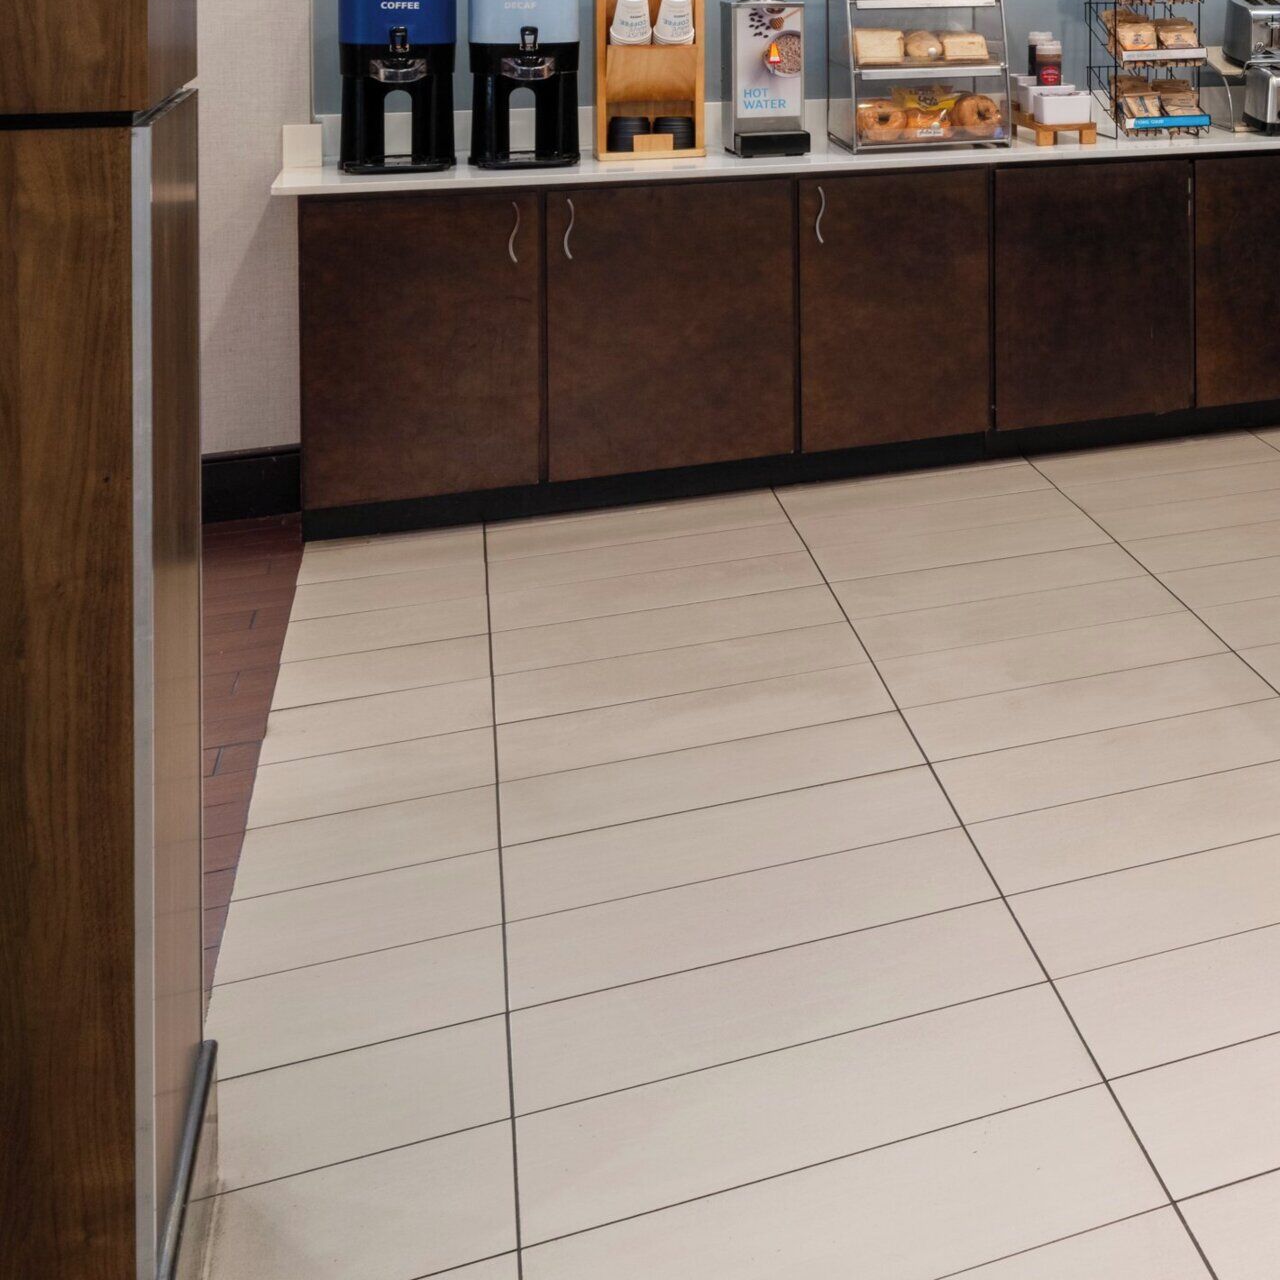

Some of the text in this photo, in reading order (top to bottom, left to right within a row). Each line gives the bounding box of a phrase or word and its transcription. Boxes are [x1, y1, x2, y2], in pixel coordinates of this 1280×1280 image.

[380, 1, 420, 10] COFFEE
[503, 1, 537, 10] DECAF
[743, 88, 769, 99] HOT
[743, 99, 787, 110] WATER
